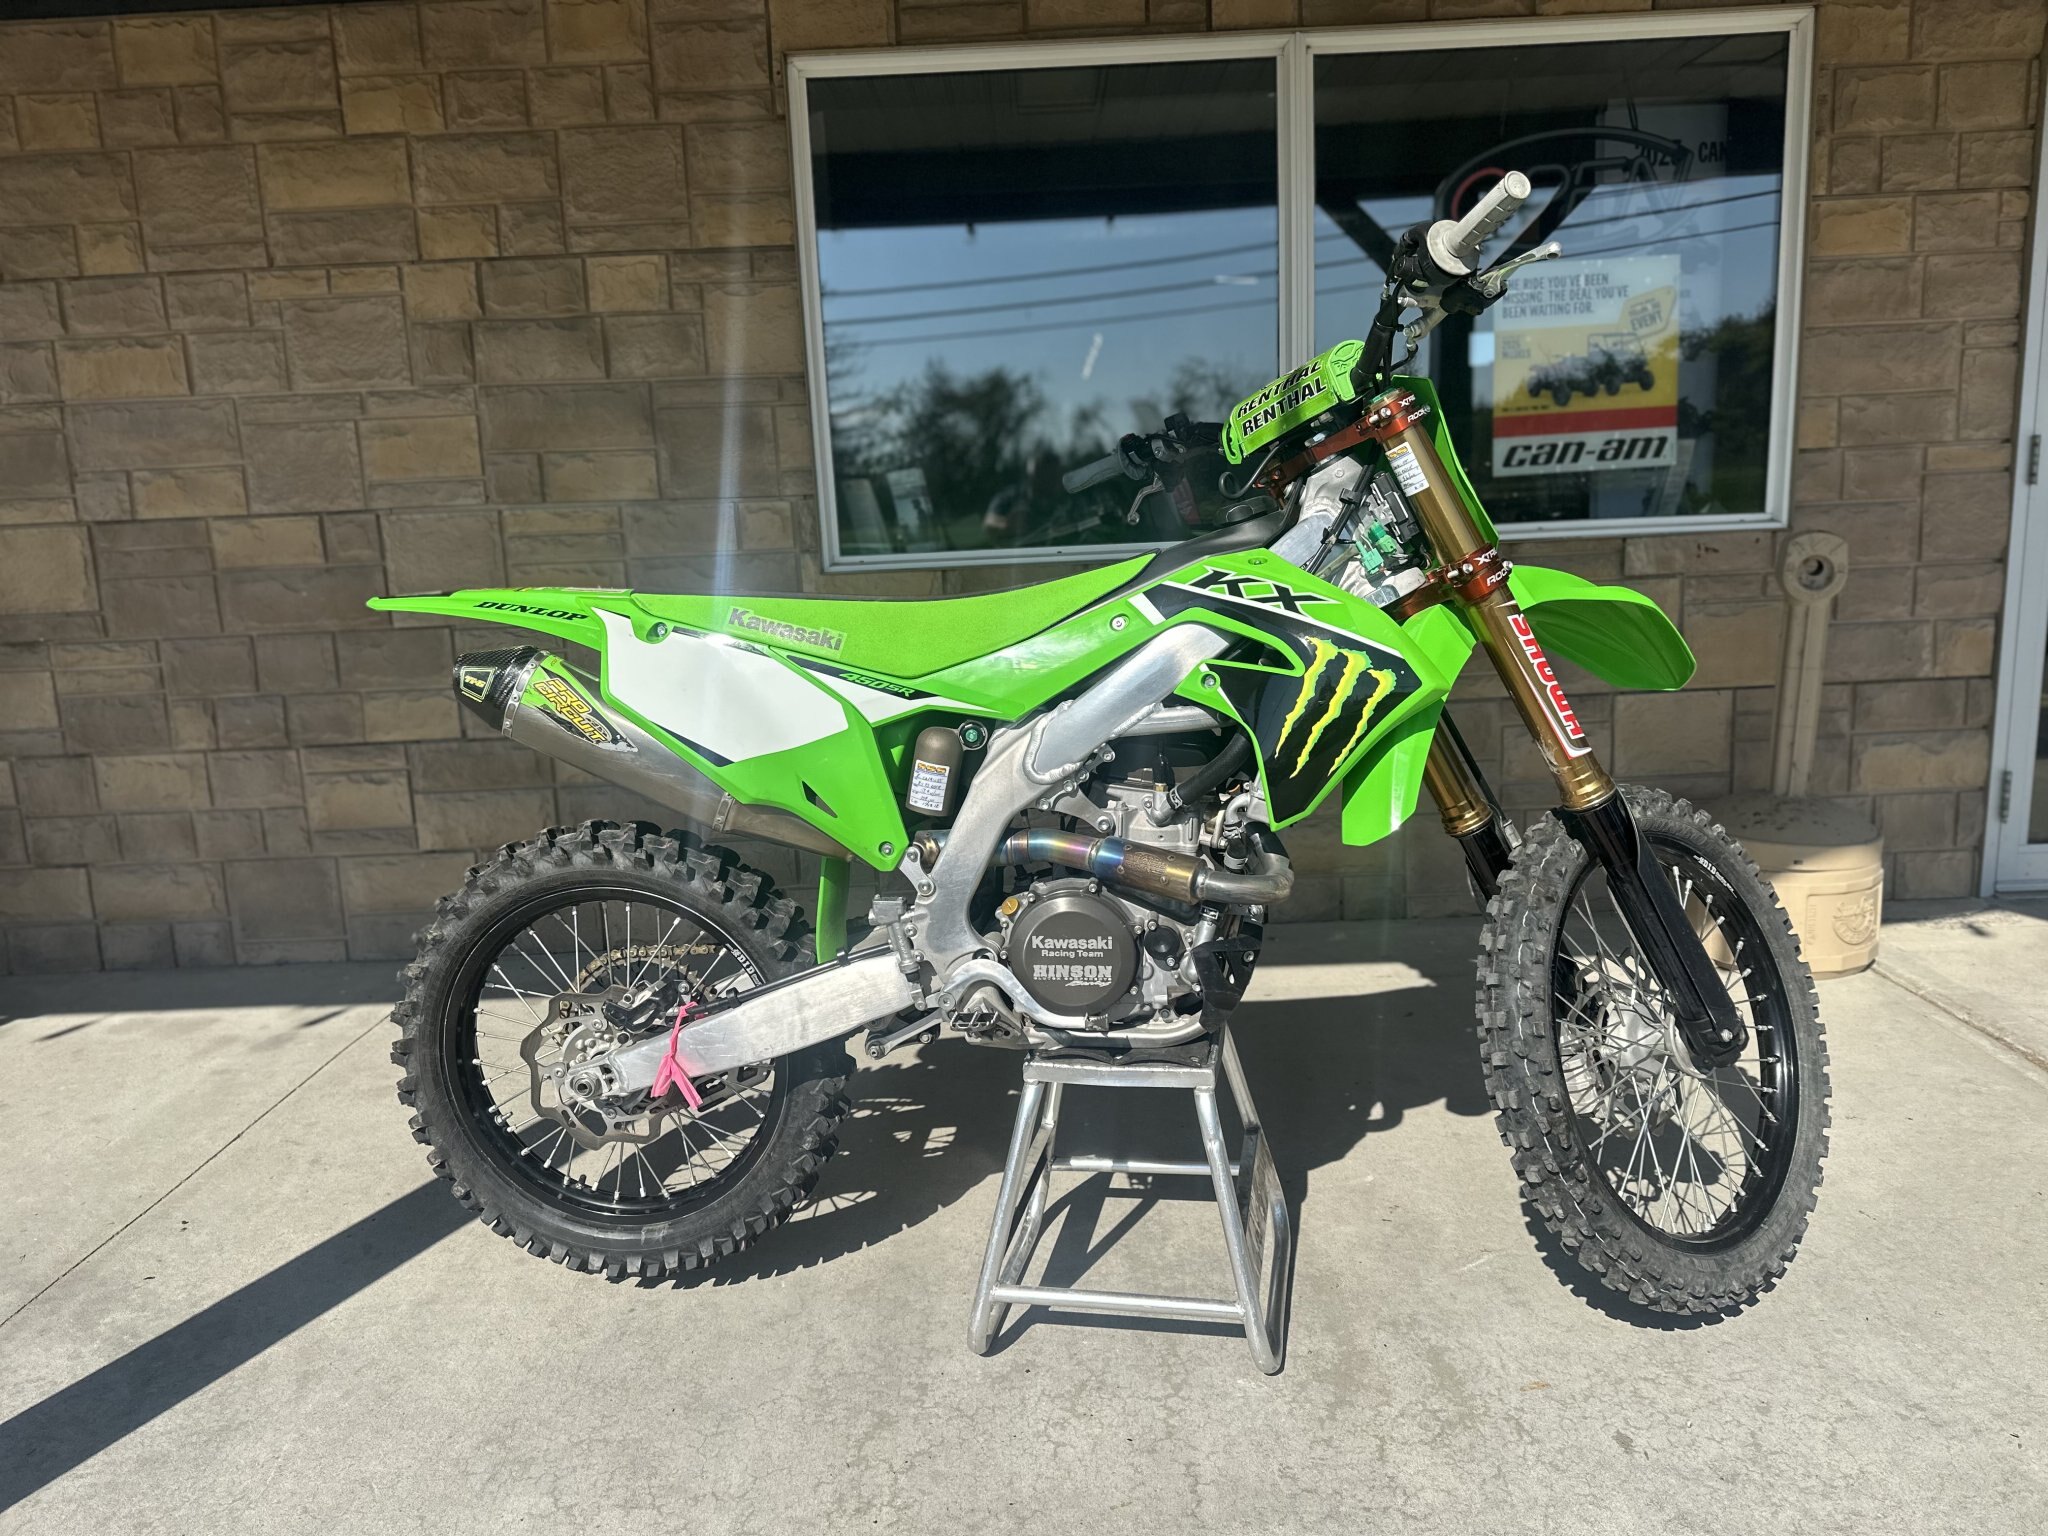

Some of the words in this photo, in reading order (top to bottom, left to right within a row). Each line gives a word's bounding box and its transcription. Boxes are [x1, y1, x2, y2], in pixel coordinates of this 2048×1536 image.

[1507, 278, 1520, 290] HE
[1523, 277, 1544, 290] RIDE
[1584, 272, 1609, 286] BEEN
[1549, 289, 1565, 301] THE
[1569, 287, 1592, 301] DEAL
[1502, 306, 1527, 319] BEEN
[1530, 303, 1571, 315] WAITING
[1630, 309, 1663, 331] EVENT
[1241, 377, 1328, 438] RENTHAL
[1502, 435, 1668, 468] can-am
[1186, 565, 1343, 619] KX
[473, 601, 589, 621] DUNLOP
[728, 607, 843, 652] Kawasaki
[1507, 612, 1585, 740] SHOWA
[548, 678, 592, 715] PRO
[533, 682, 610, 743] CIRCUIT
[1031, 935, 1113, 950] Kawasaki
[1041, 950, 1075, 958] Racing
[1076, 950, 1104, 958] Team
[1033, 965, 1113, 978] HINSON
